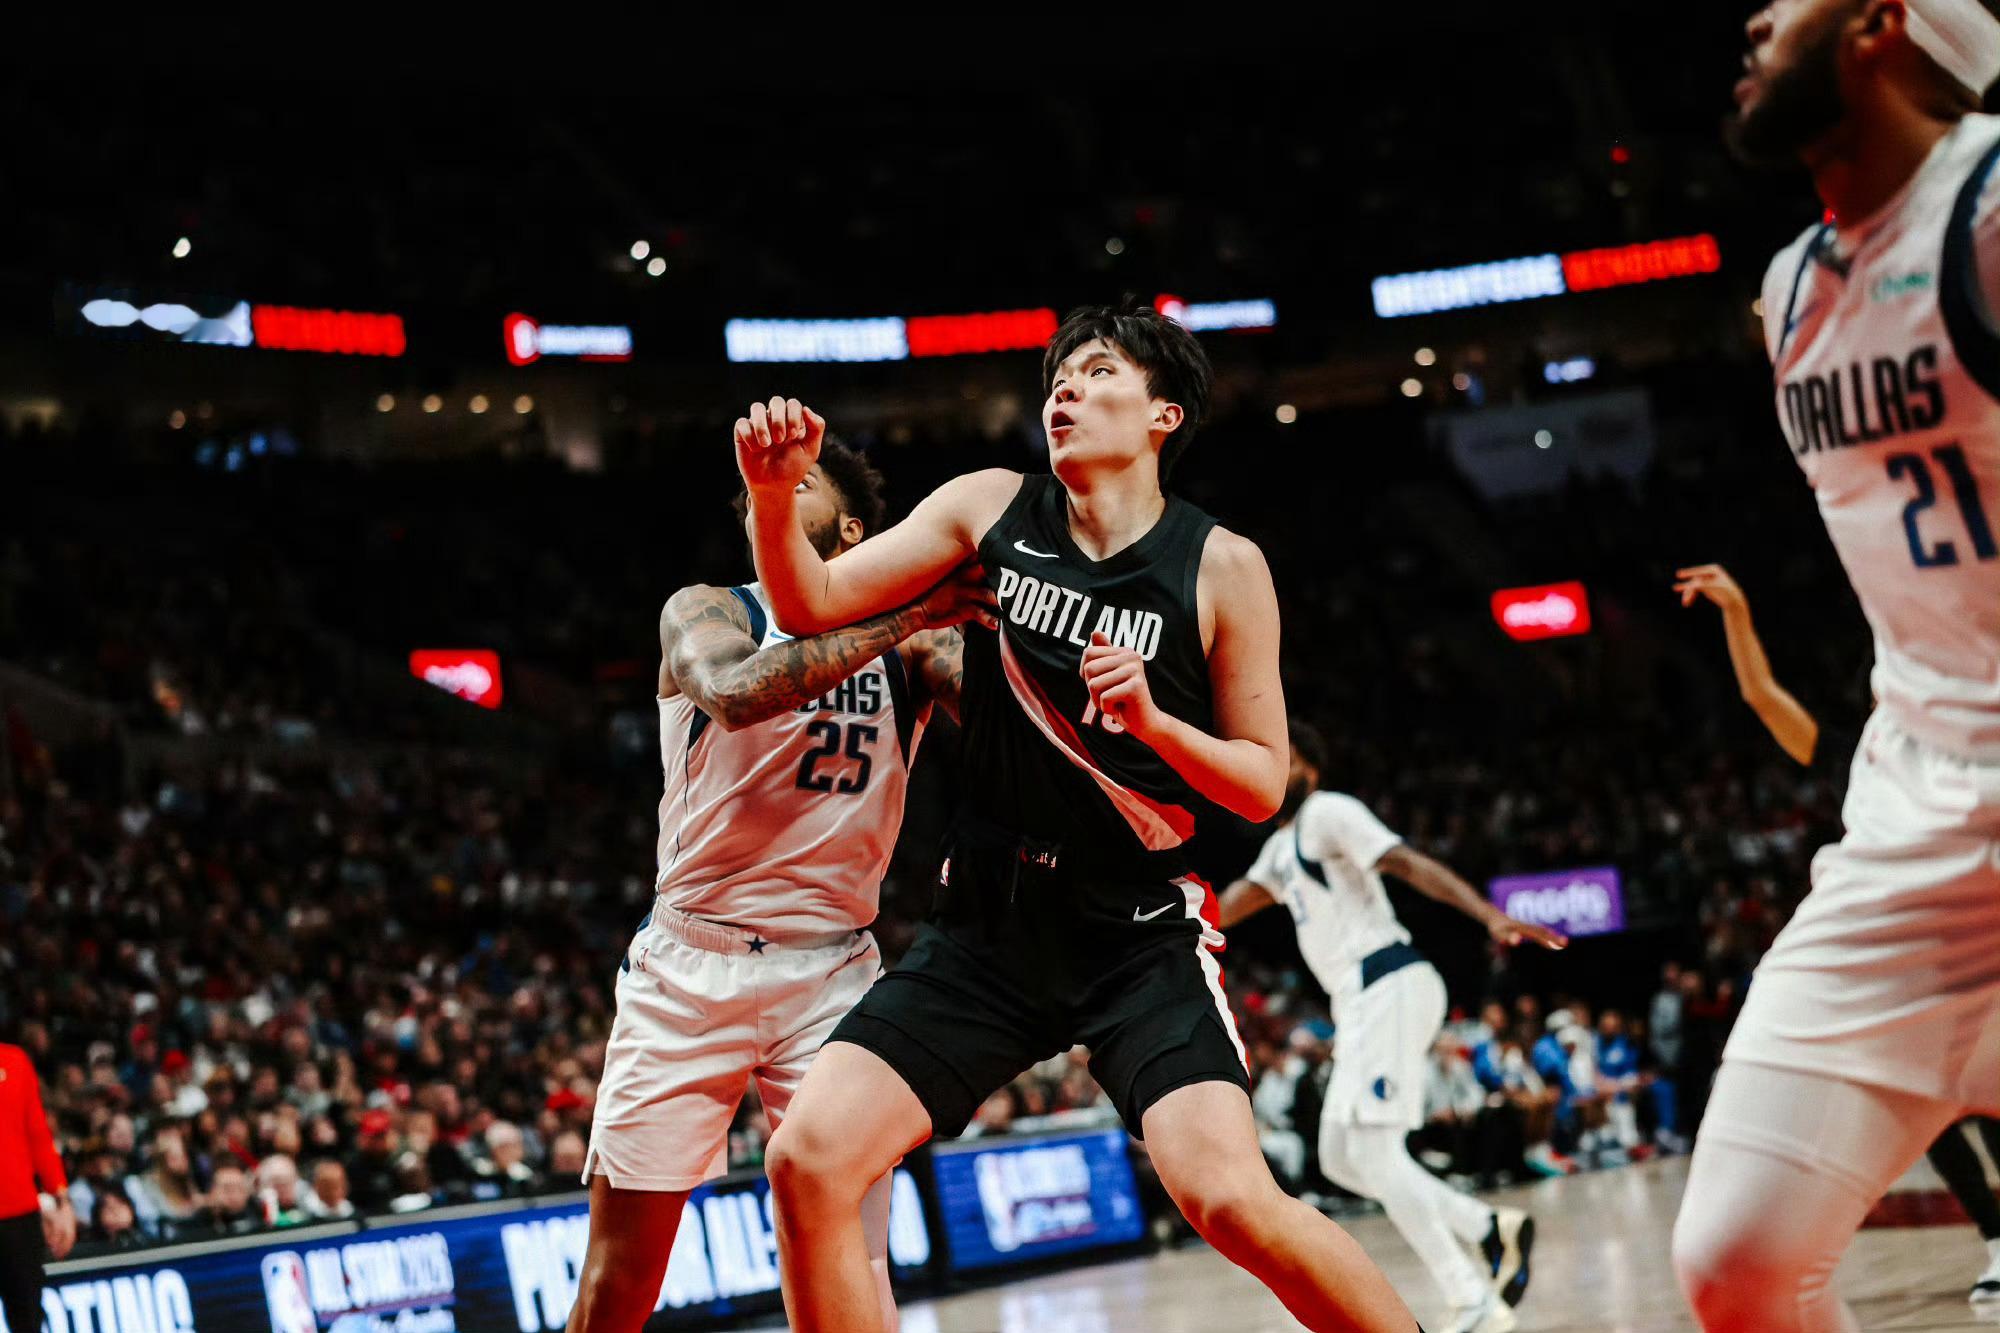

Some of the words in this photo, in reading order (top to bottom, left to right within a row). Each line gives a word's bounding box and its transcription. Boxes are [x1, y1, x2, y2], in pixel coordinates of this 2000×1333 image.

[1785, 346, 1945, 455] DALLAS
[1886, 439, 1997, 568] 21
[997, 567, 1163, 661] PORTLAND
[795, 721, 879, 795] 25
